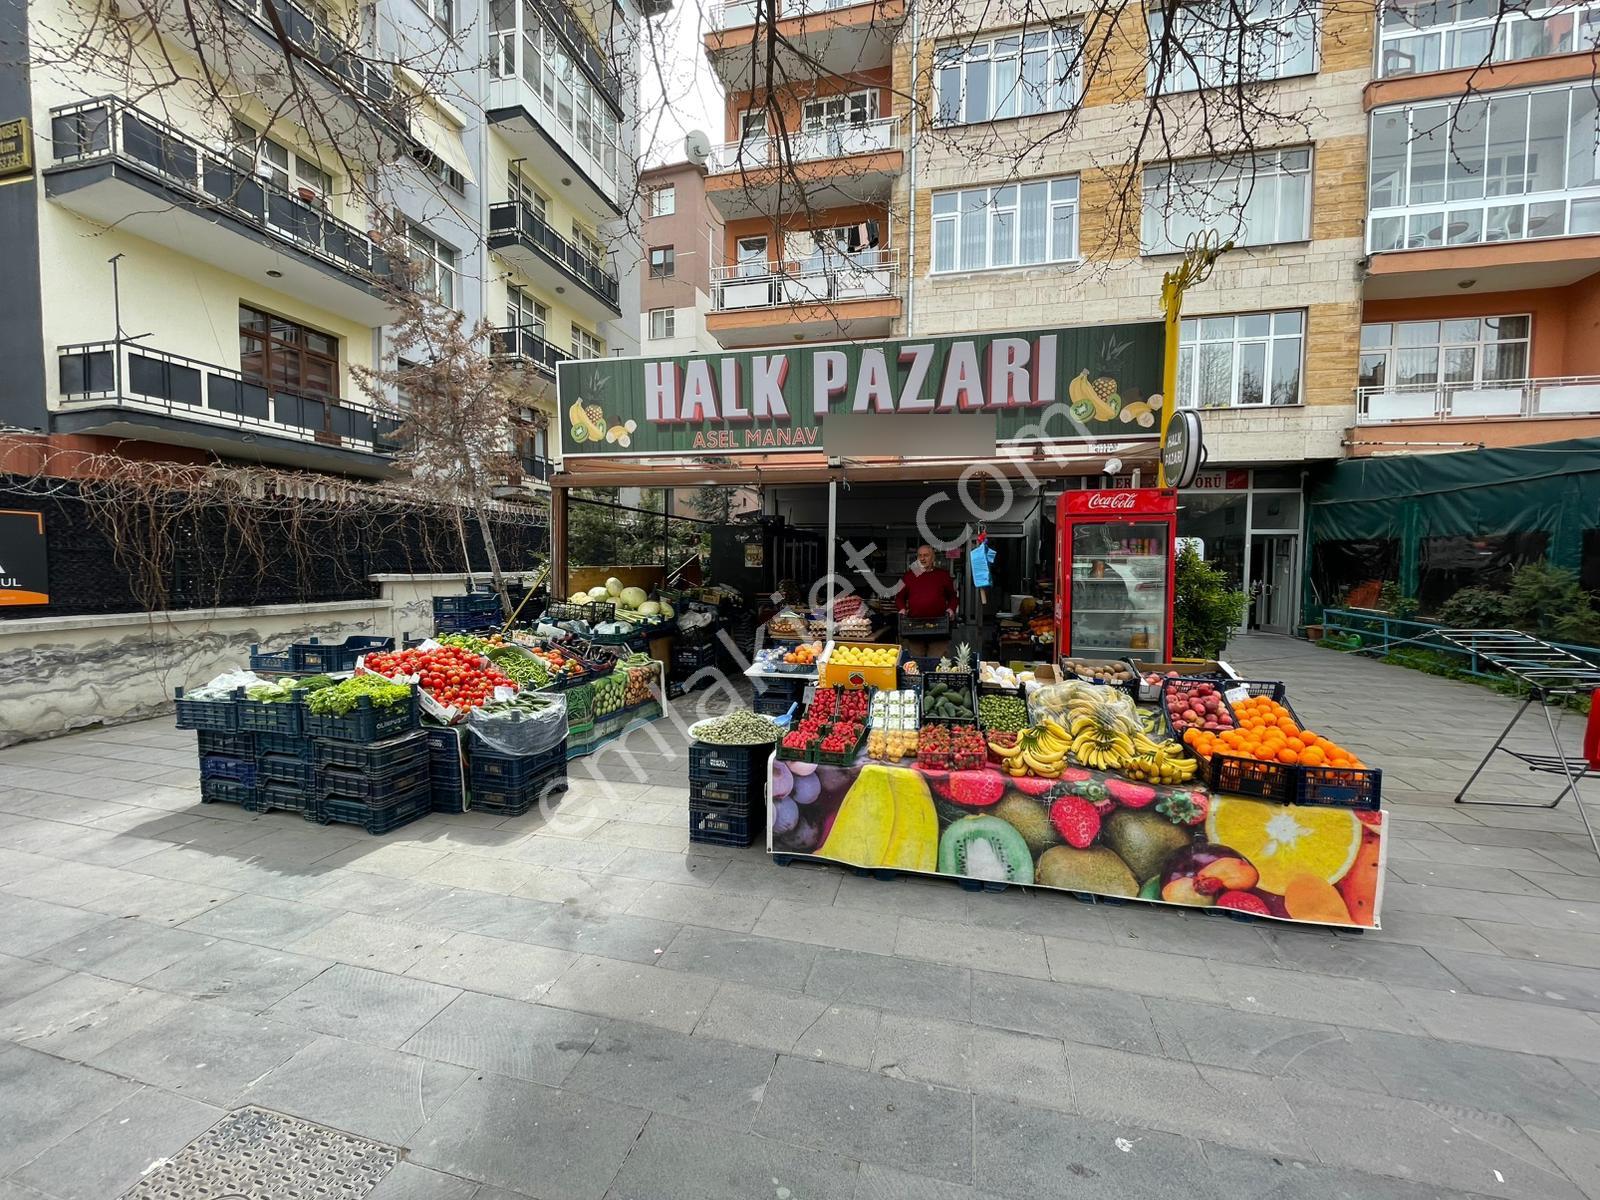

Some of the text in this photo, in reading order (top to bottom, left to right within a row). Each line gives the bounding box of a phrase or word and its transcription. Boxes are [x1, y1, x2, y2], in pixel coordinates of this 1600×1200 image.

[644, 333, 1058, 425] HALK PAZARI
[692, 426, 819, 449] ASEL MANAV
[1088, 493, 1138, 509] Coca-Cola
[0, 577, 23, 587] UL
